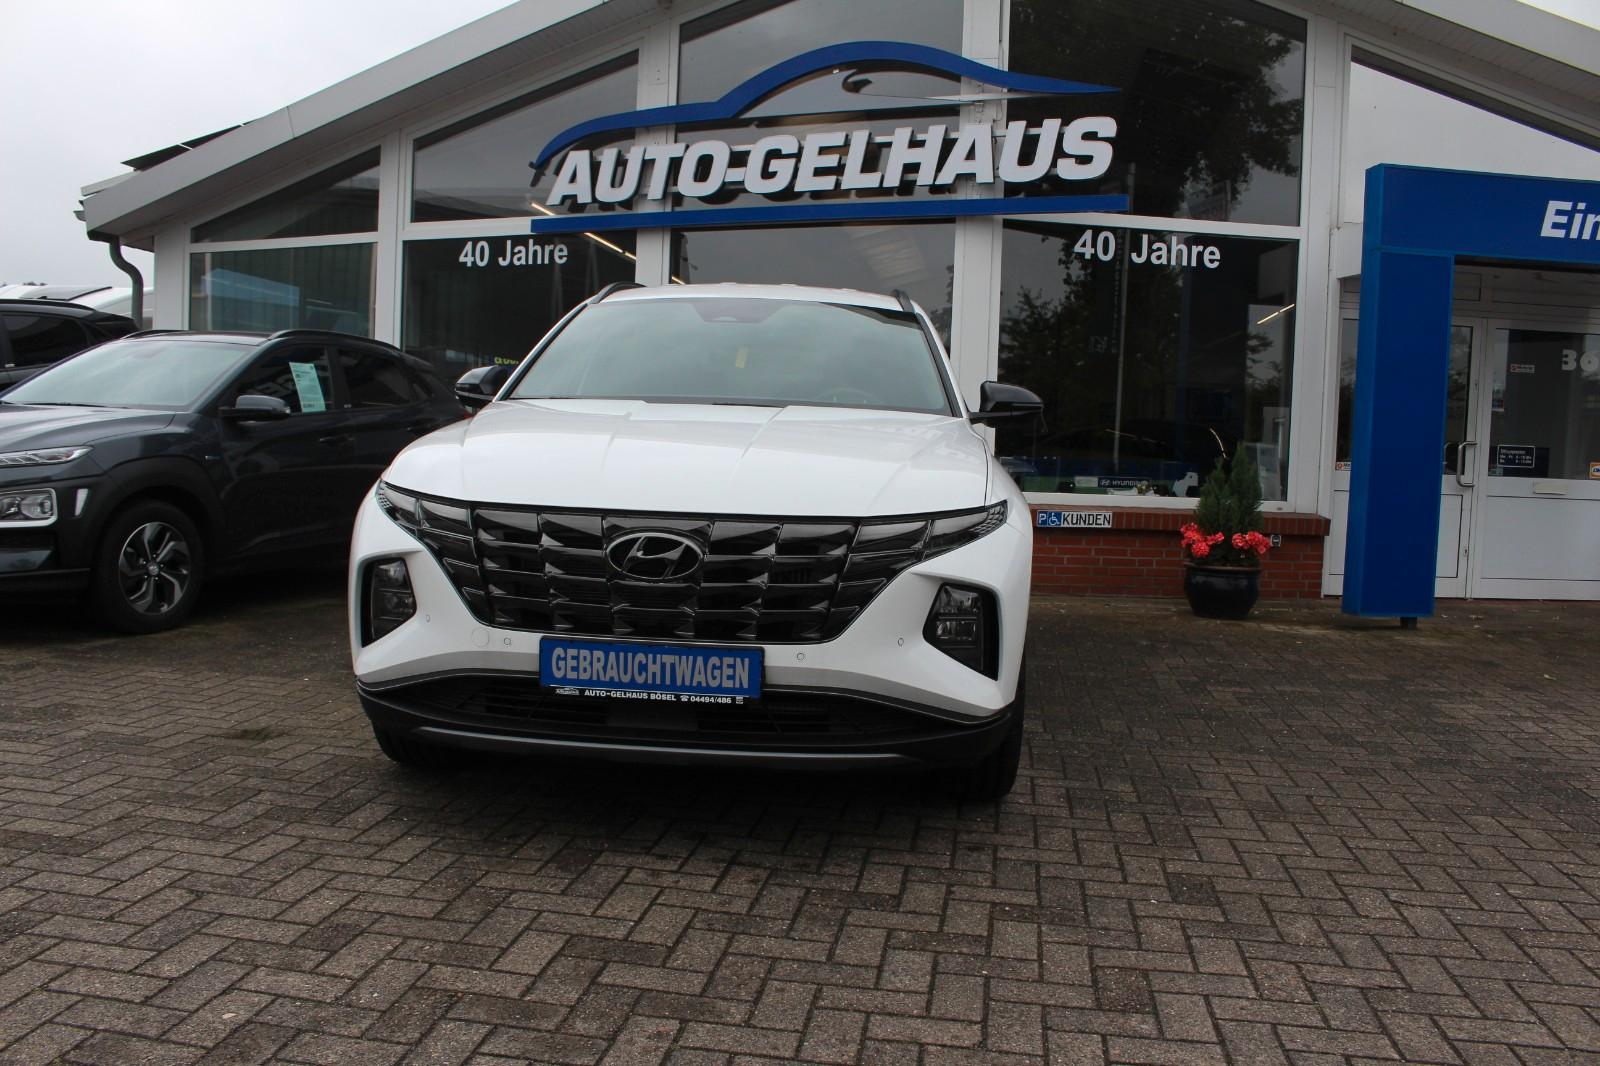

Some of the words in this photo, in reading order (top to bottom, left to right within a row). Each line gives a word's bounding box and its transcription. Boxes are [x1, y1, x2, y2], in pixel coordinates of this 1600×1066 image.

[547, 115, 1119, 206] AUTO-GELHAUS
[458, 239, 490, 268] 40
[498, 238, 569, 267] Jahre
[1073, 228, 1116, 262] 40
[1130, 233, 1221, 269] Jahre
[1062, 512, 1112, 526] KUNDEN
[551, 647, 749, 689] GEBRAUCHTWAGEN
[584, 689, 648, 700] AUTO-GELHAUS
[650, 691, 677, 701] BÖSEL
[690, 695, 732, 704] 04494/486
